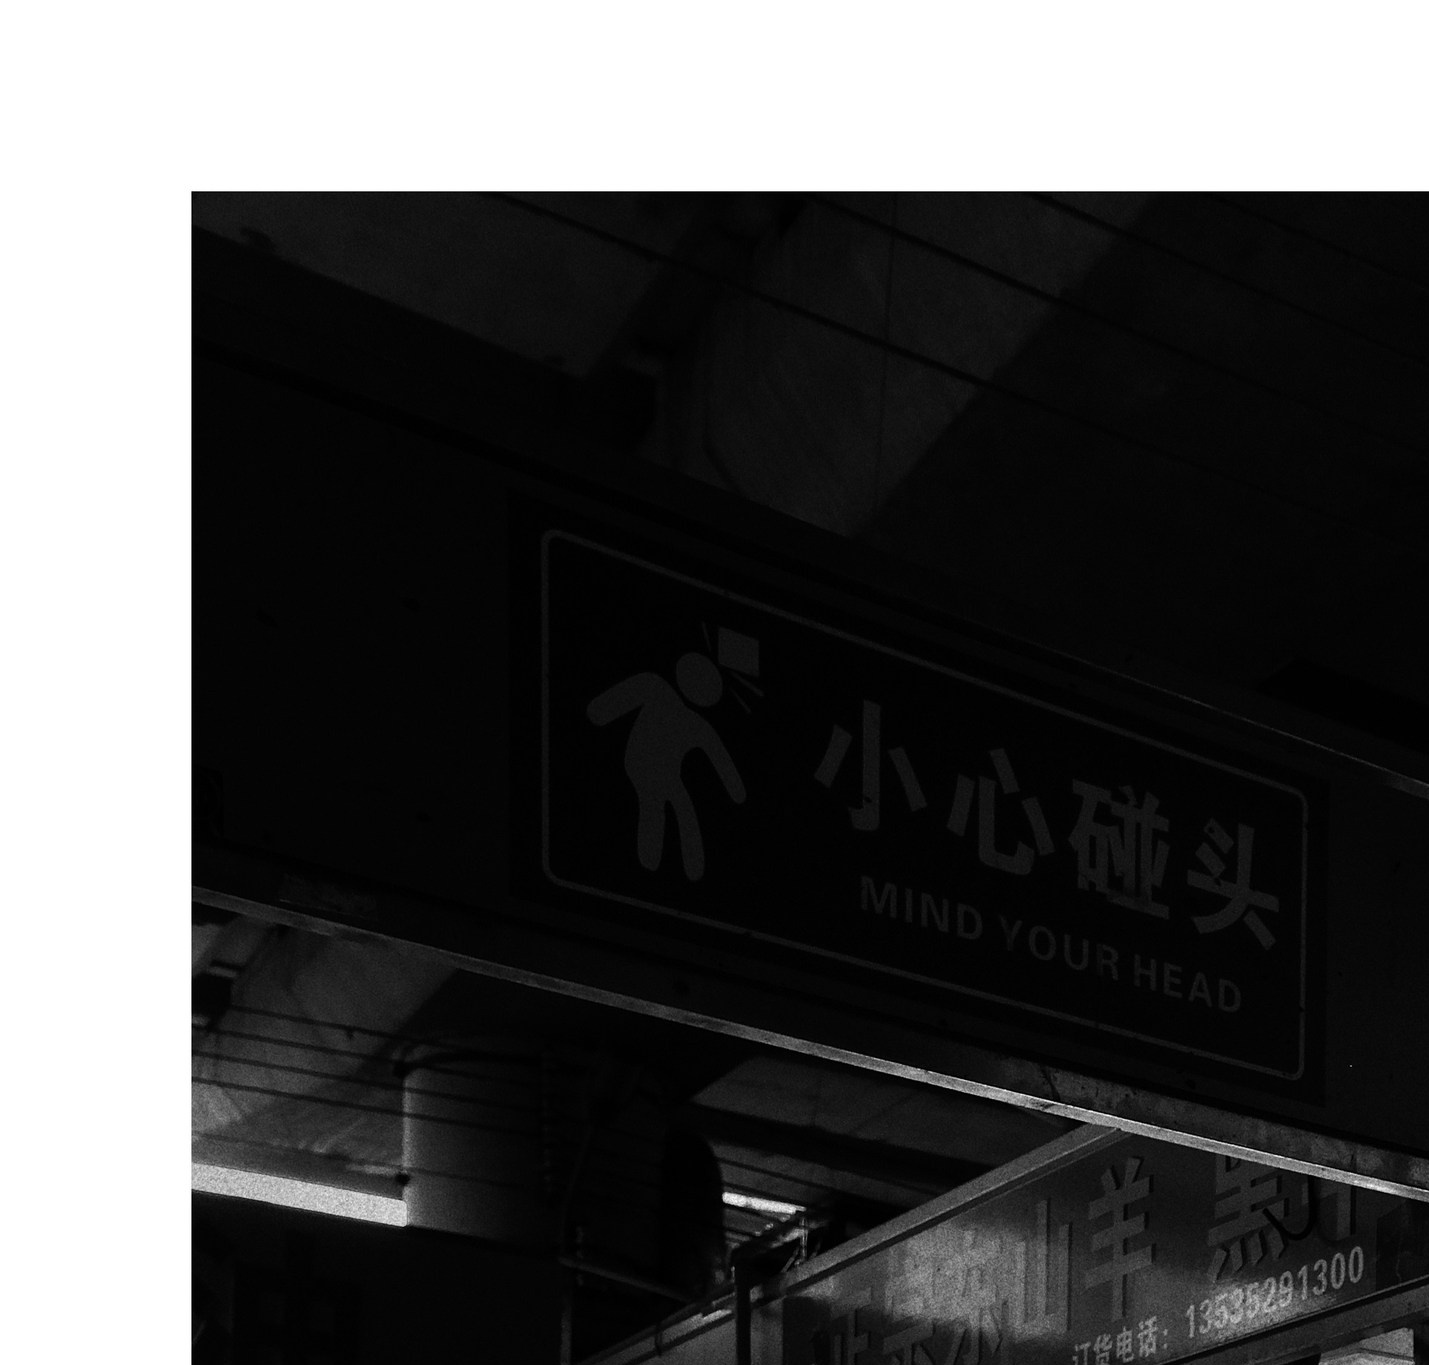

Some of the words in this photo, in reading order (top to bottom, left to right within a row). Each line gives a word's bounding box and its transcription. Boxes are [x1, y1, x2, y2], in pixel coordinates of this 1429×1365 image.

[813, 698, 1281, 951] 小心碰头
[860, 873, 985, 941] MIND
[999, 913, 1122, 982] YOUR
[1131, 953, 1244, 1016] HEAD
[1207, 1154, 1354, 1284] 黑
[1184, 1245, 1365, 1339] 13535291300
